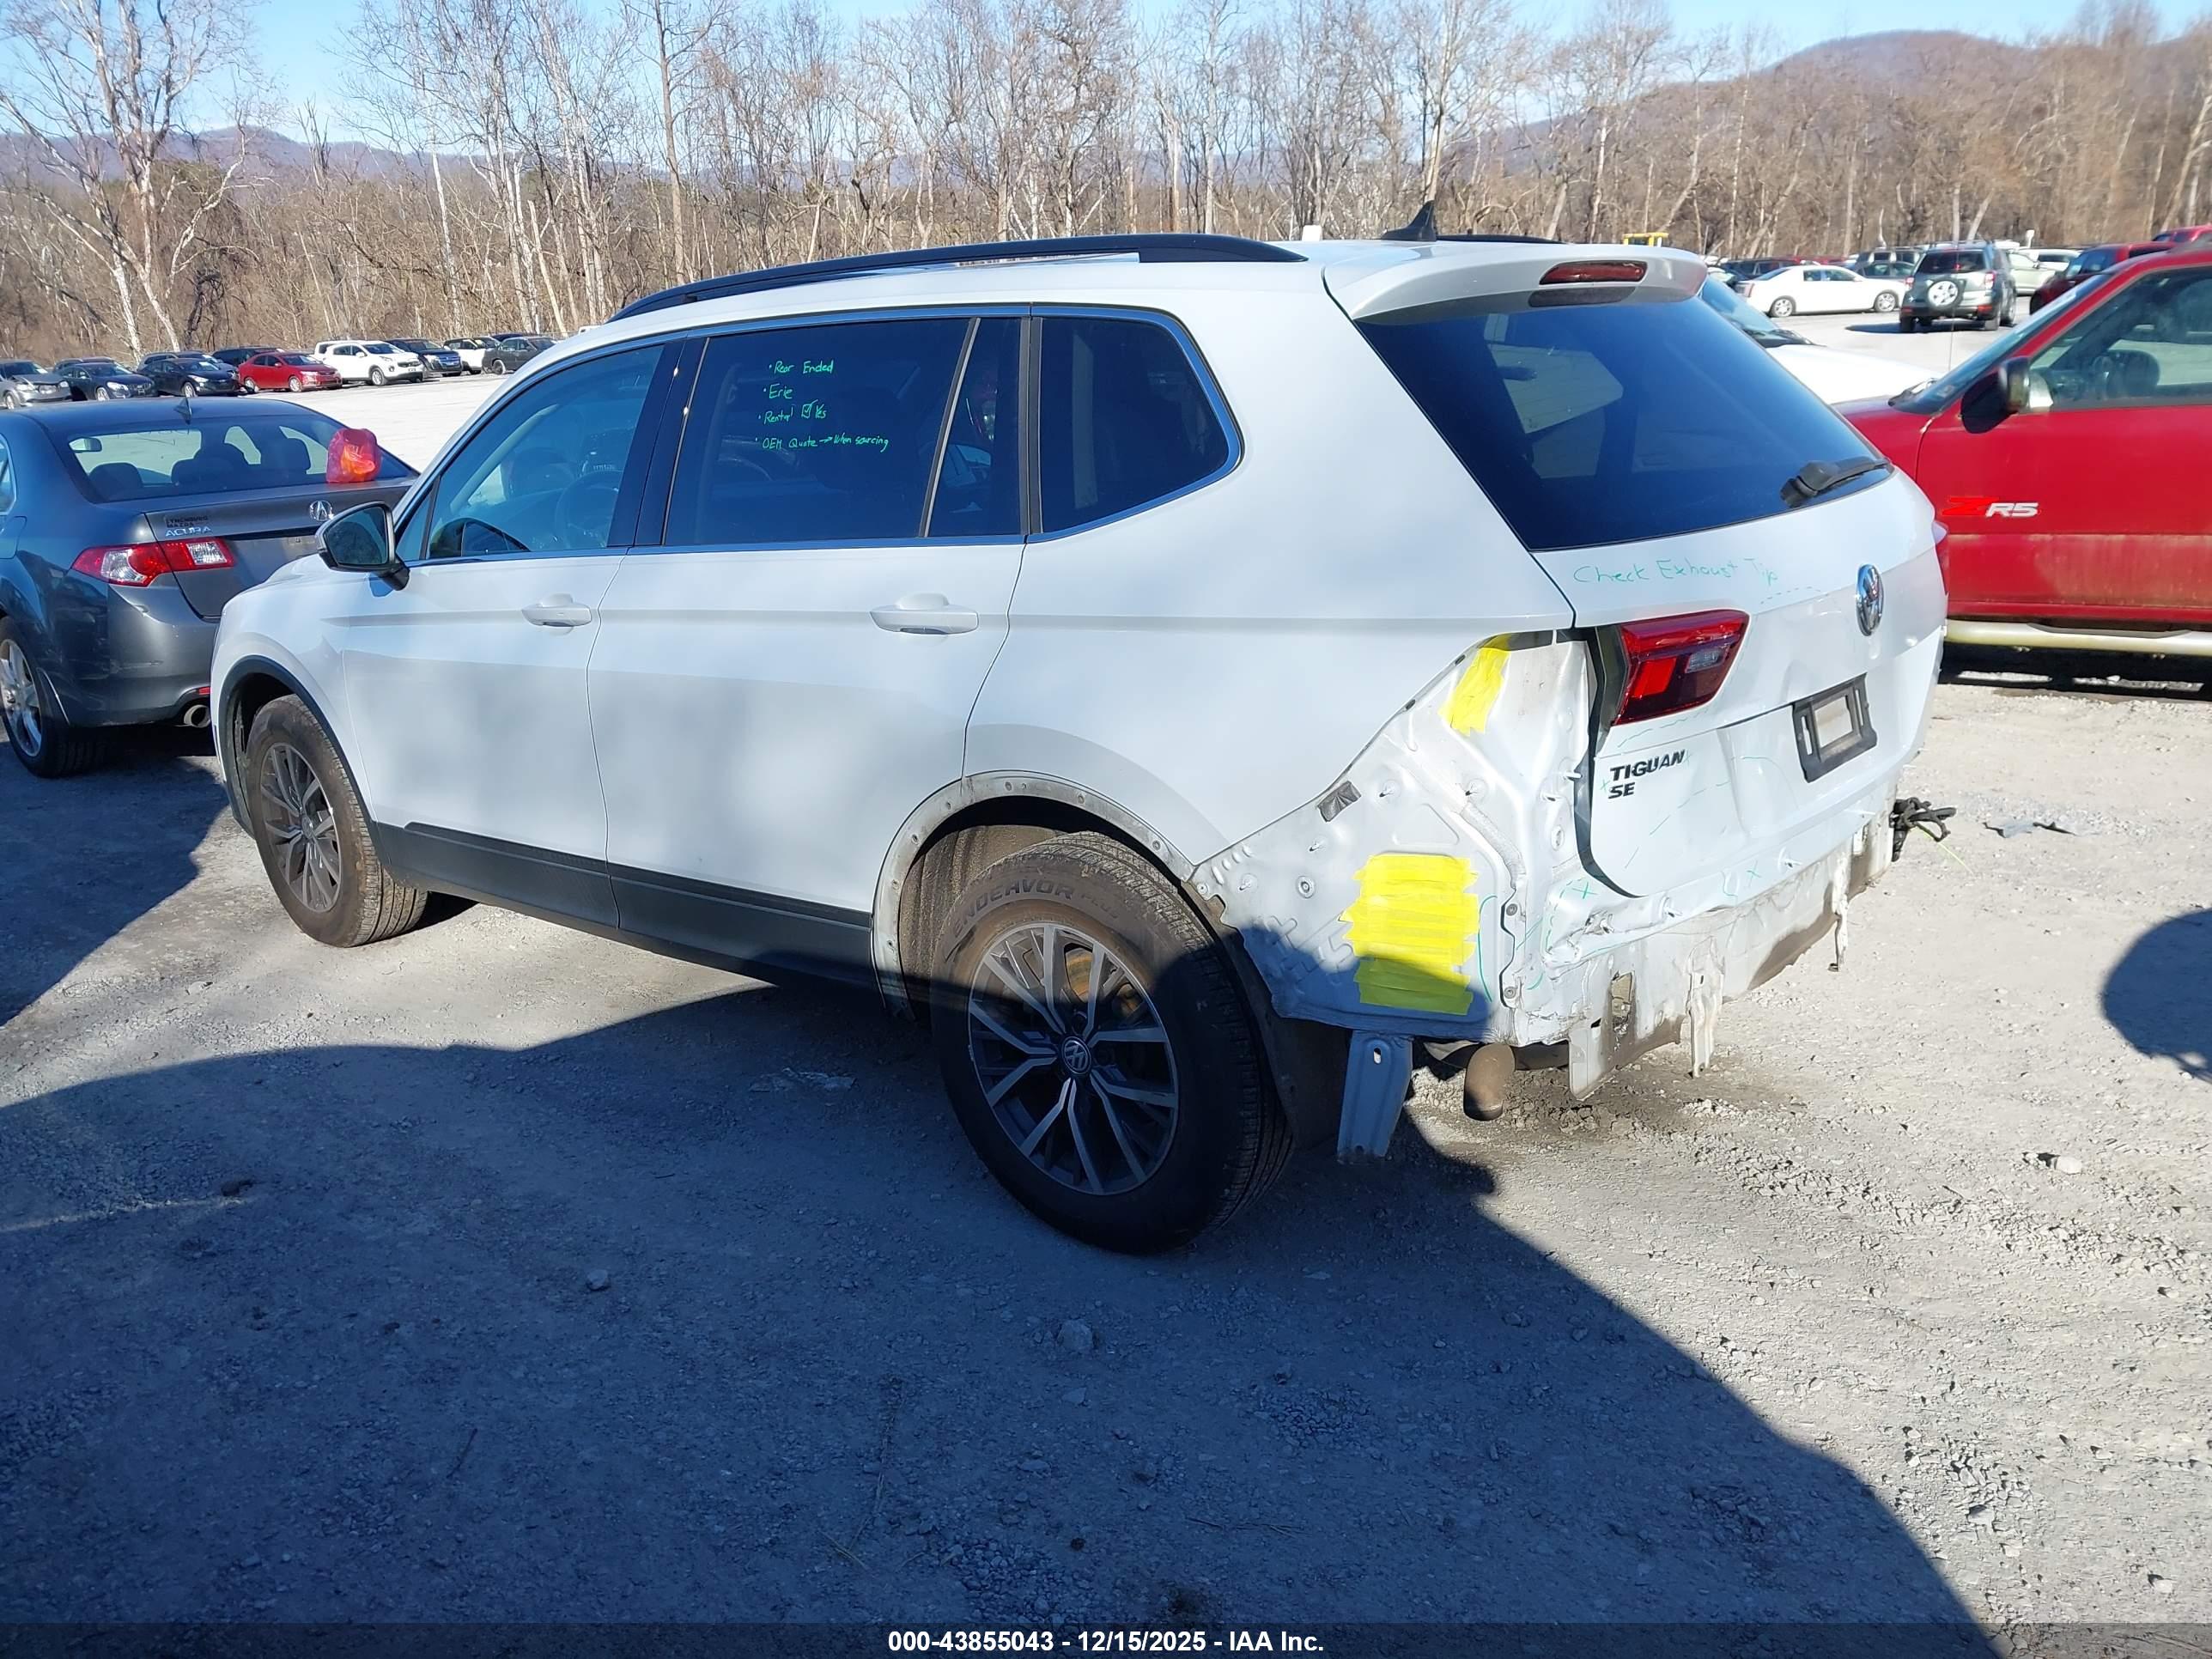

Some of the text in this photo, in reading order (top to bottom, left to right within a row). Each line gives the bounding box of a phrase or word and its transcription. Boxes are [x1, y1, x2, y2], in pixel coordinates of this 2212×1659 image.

[774, 359, 835, 374] Rear Ended
[769, 383, 793, 399] Erie
[763, 404, 827, 424] Rental Yes
[788, 435, 817, 449] Quote
[855, 435, 890, 453] sourcing
[166, 526, 211, 537] ACURA
[1573, 564, 1649, 583] Check
[1656, 557, 1738, 580] Exhaust
[1609, 749, 1686, 782] TIGUAN
[1607, 782, 1636, 799] SE
[953, 878, 1075, 938] ENDEAVOR
